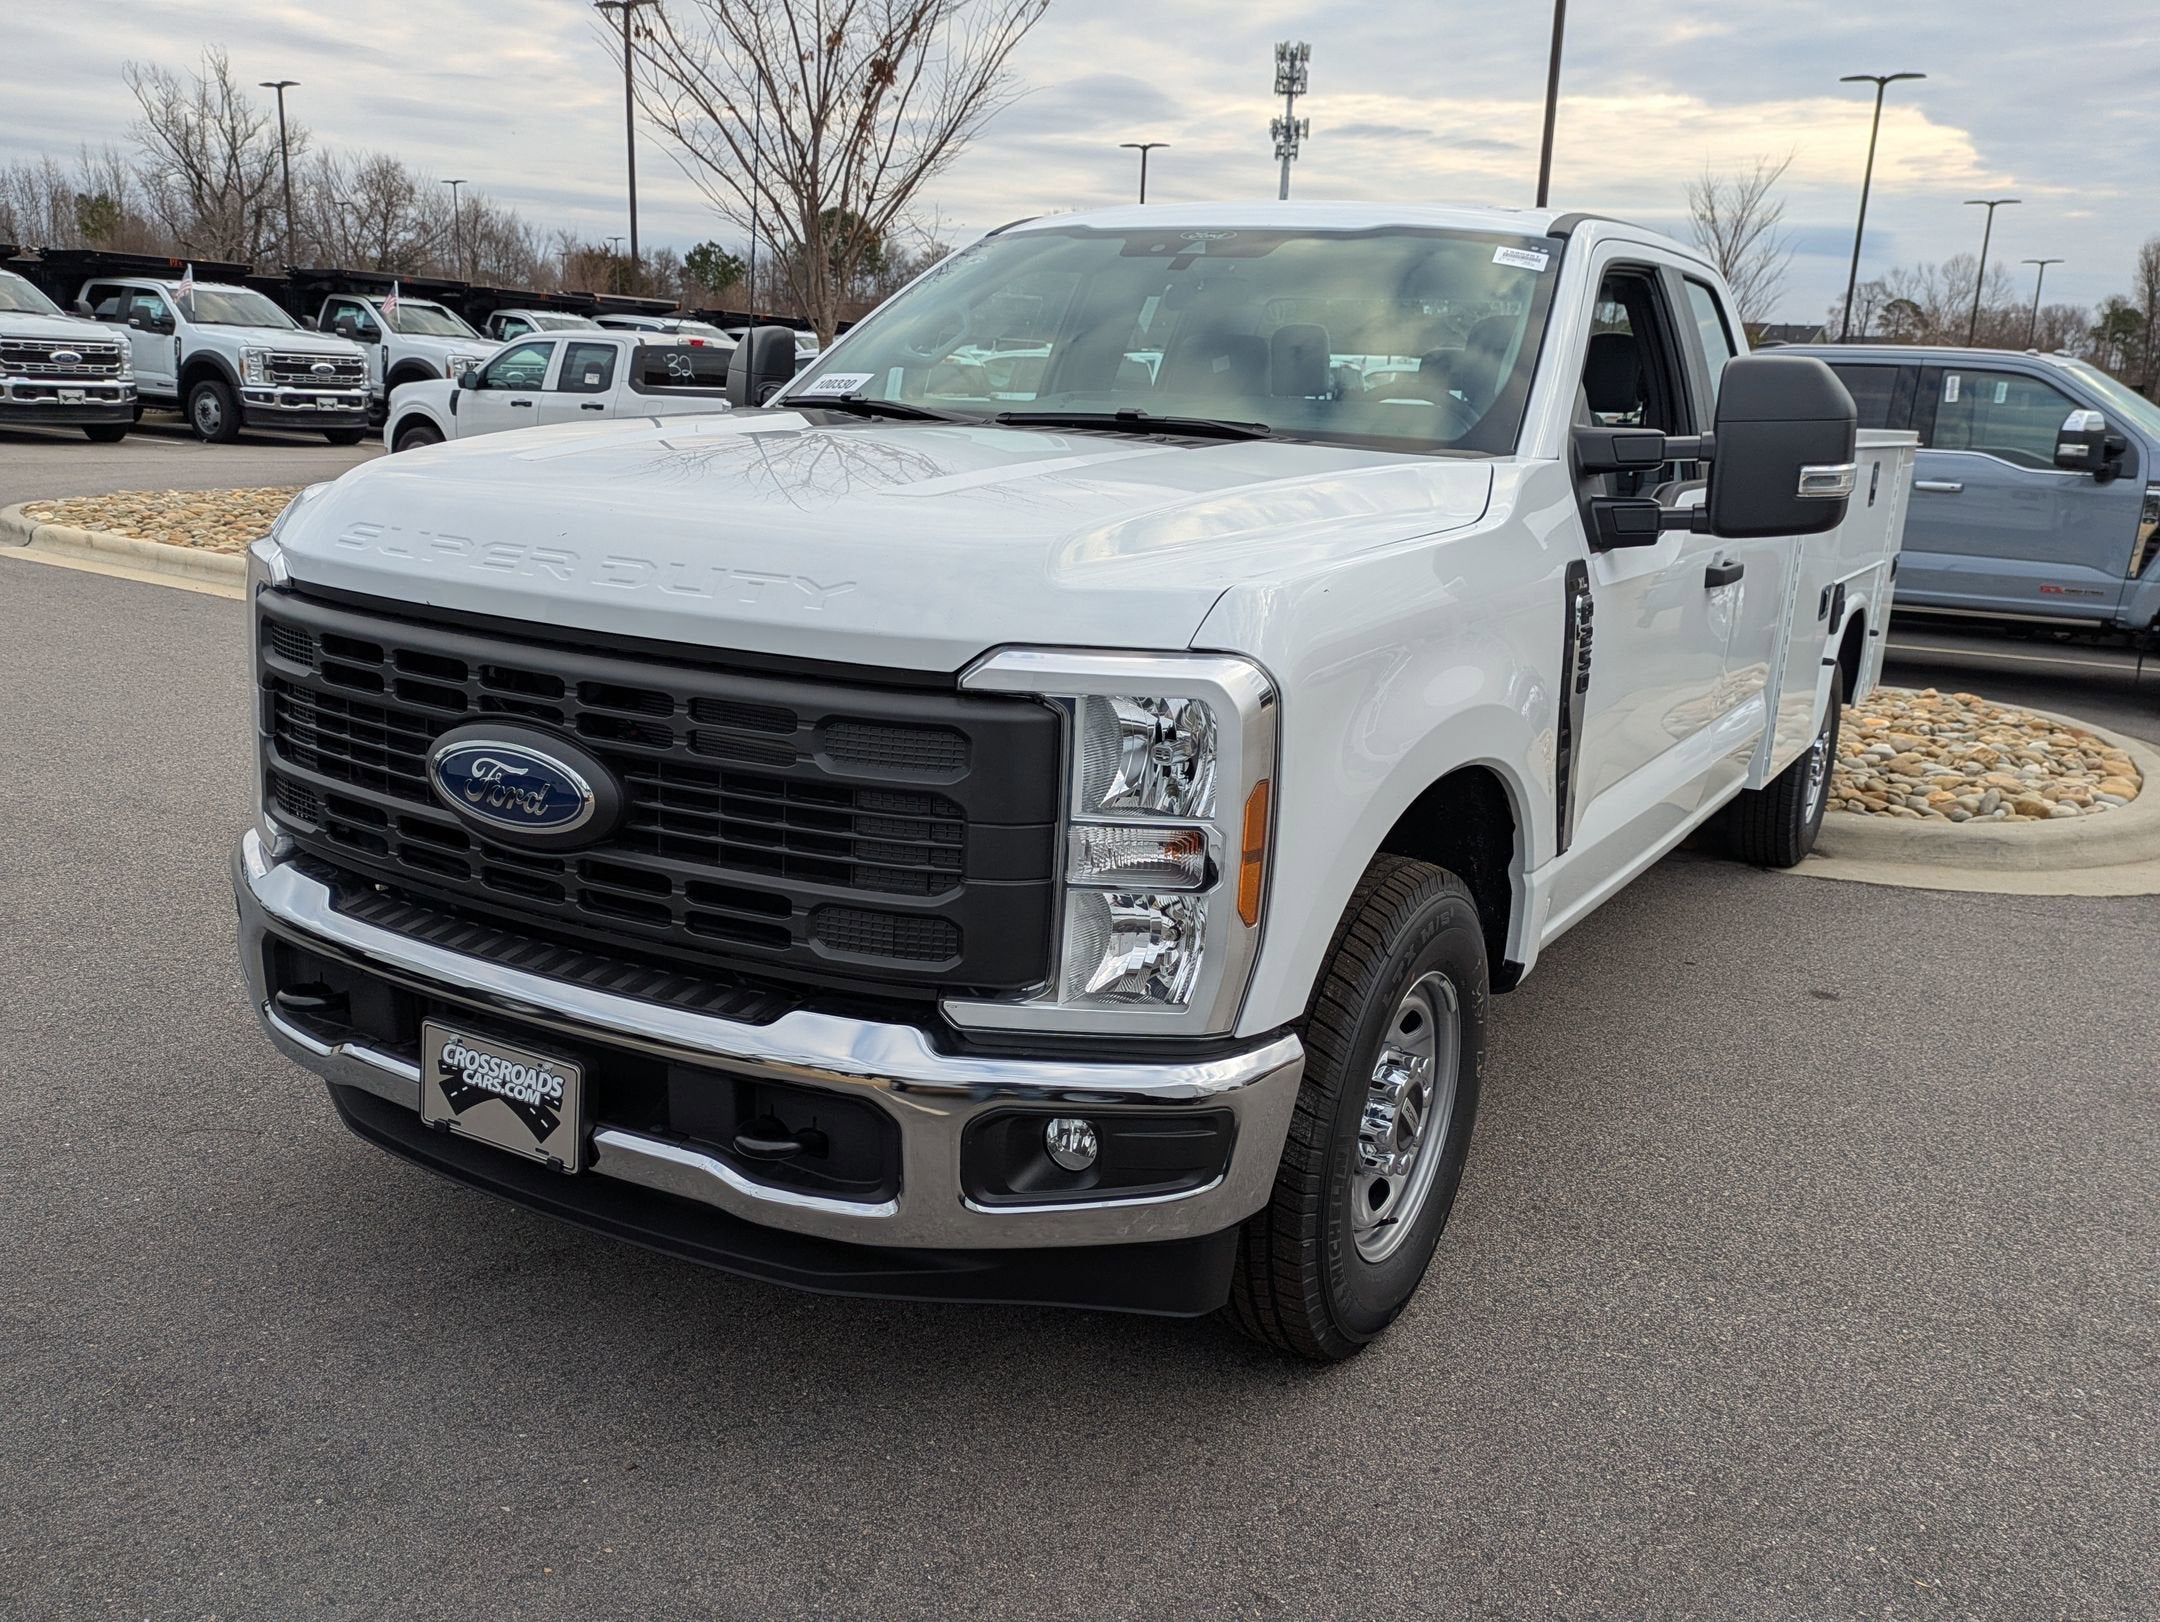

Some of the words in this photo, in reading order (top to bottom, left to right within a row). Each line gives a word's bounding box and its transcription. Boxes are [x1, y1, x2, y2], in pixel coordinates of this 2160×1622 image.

[335, 521, 582, 581] SUPER
[592, 554, 857, 611] DUTY
[464, 757, 551, 816] Ford
[441, 1043, 565, 1099] CROSSROADS
[462, 1070, 542, 1106] CARS.COM
